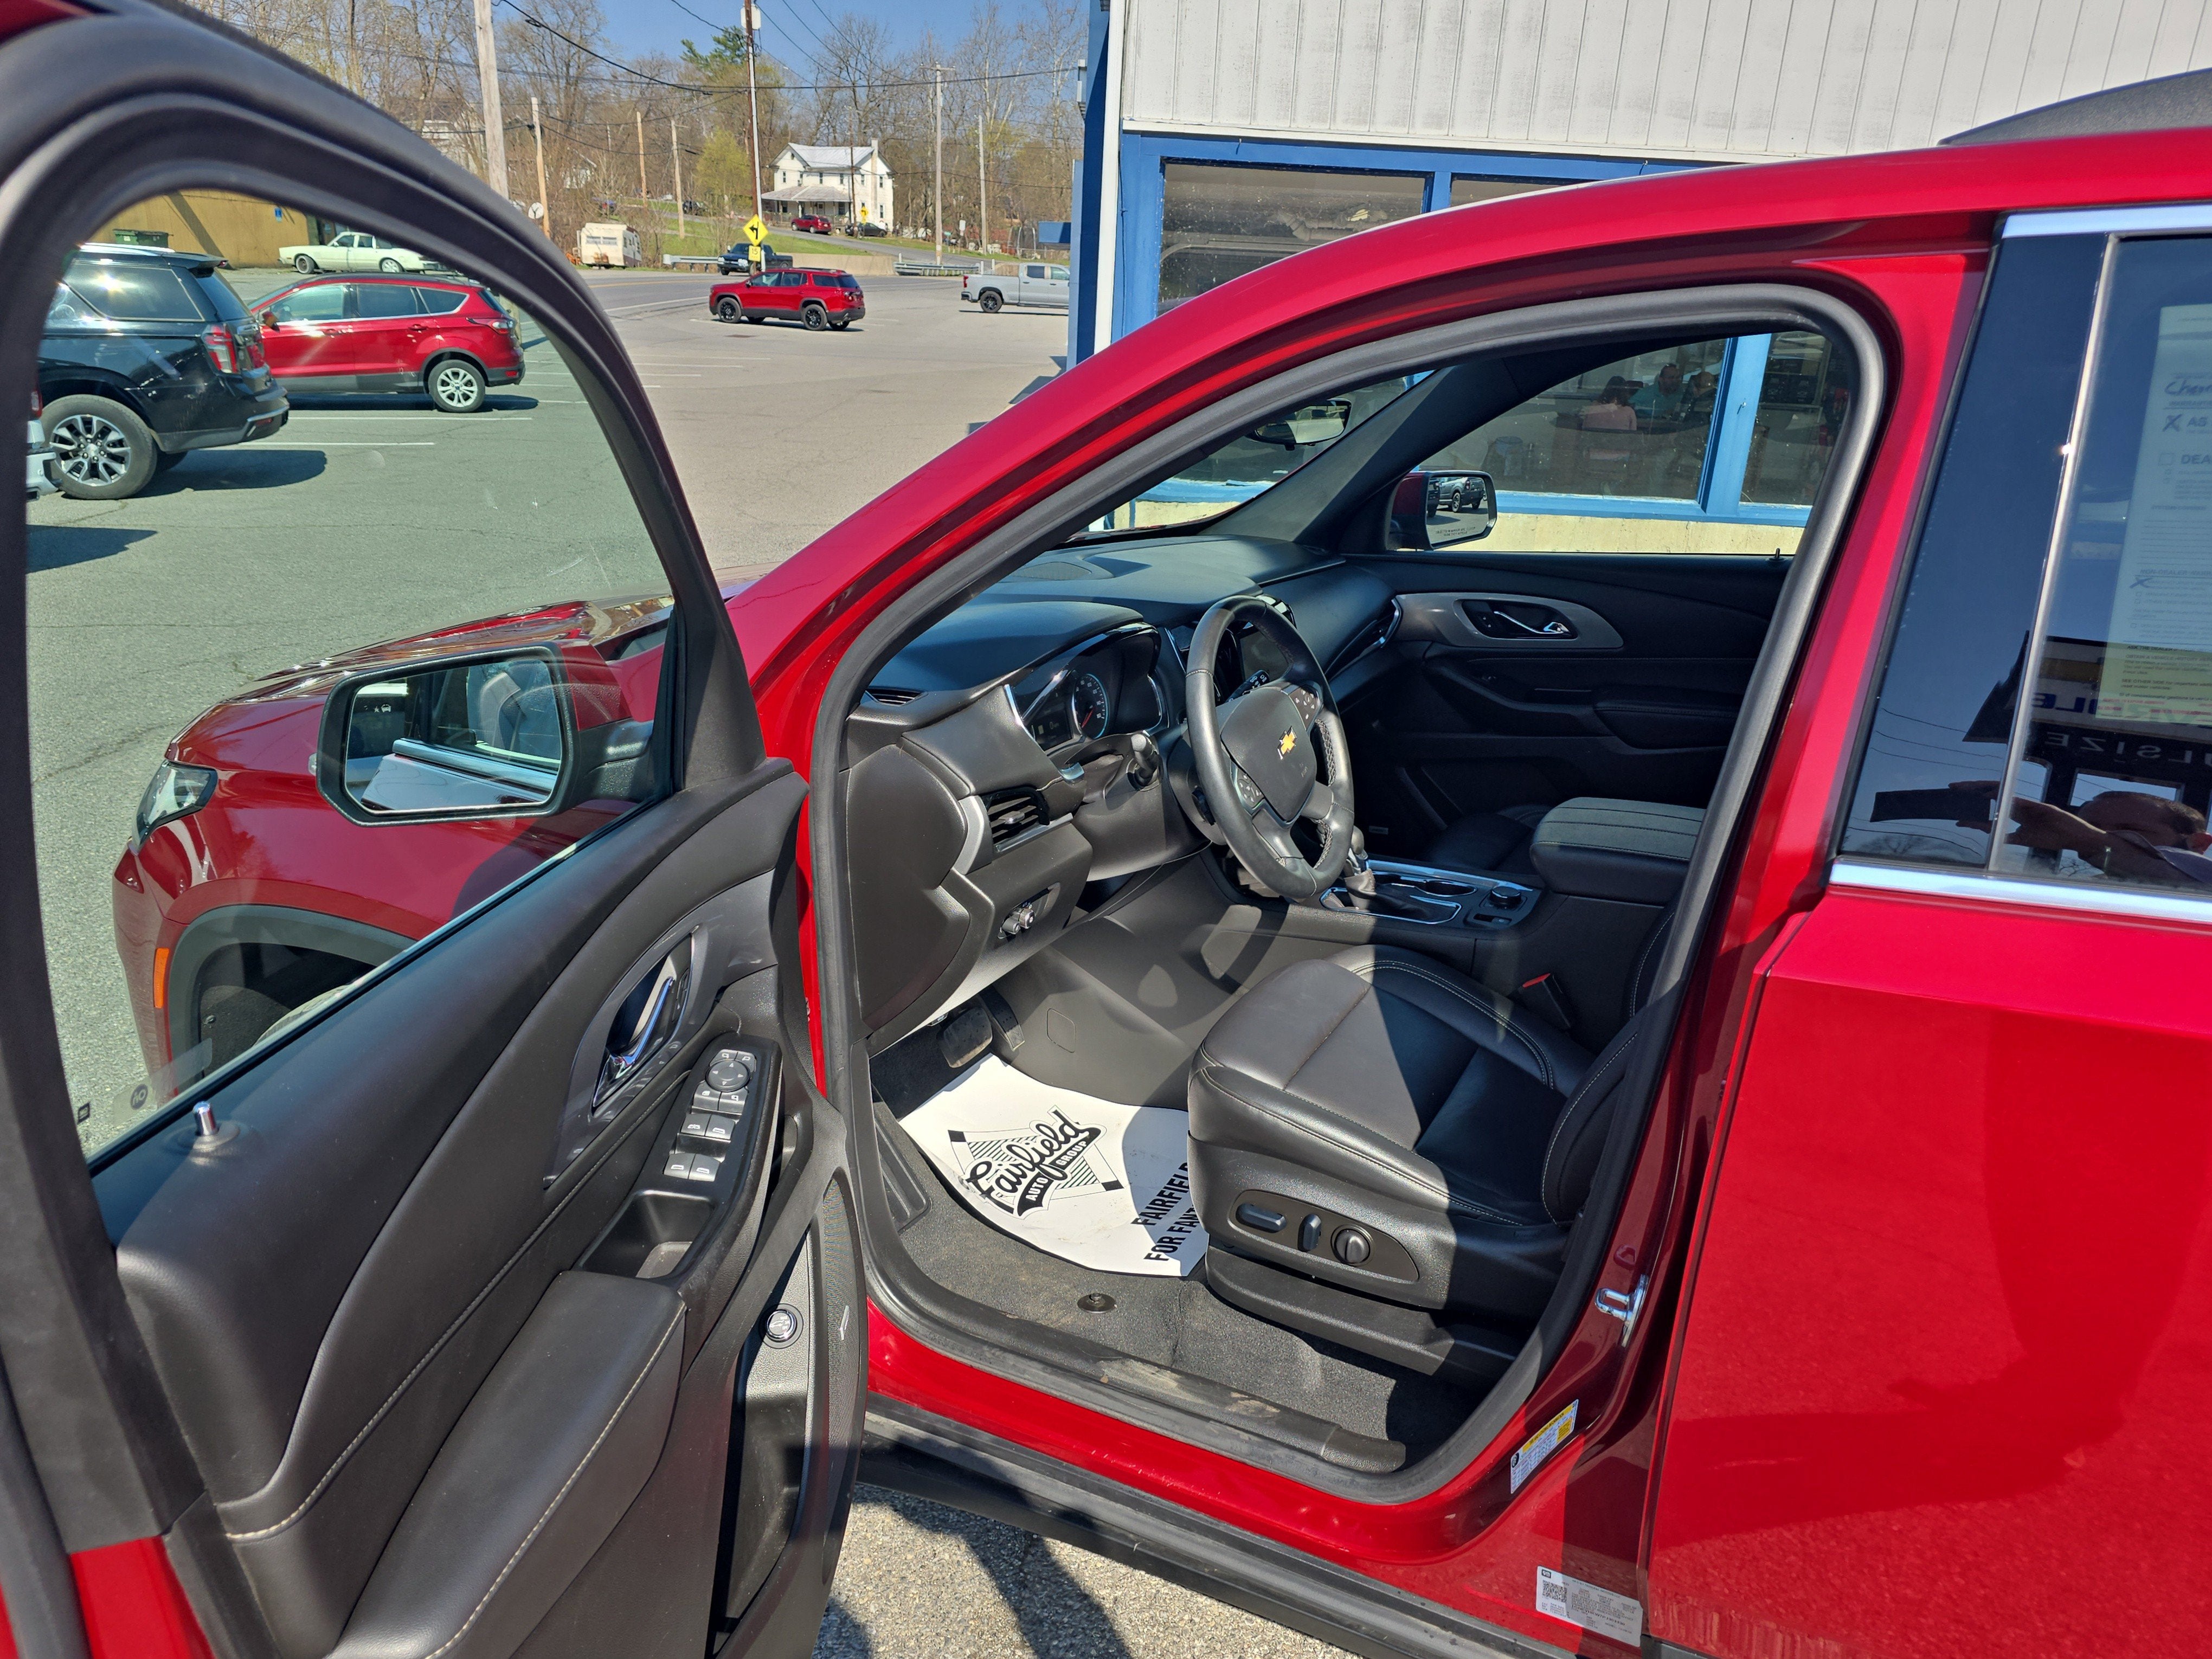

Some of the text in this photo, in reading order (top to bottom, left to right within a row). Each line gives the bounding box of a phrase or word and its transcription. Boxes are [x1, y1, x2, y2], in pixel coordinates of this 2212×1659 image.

[965, 1109, 1101, 1214] Fairfield
[1025, 1140, 1087, 1201] AUTO GROUP
[1143, 1236, 1186, 1261] FOR
